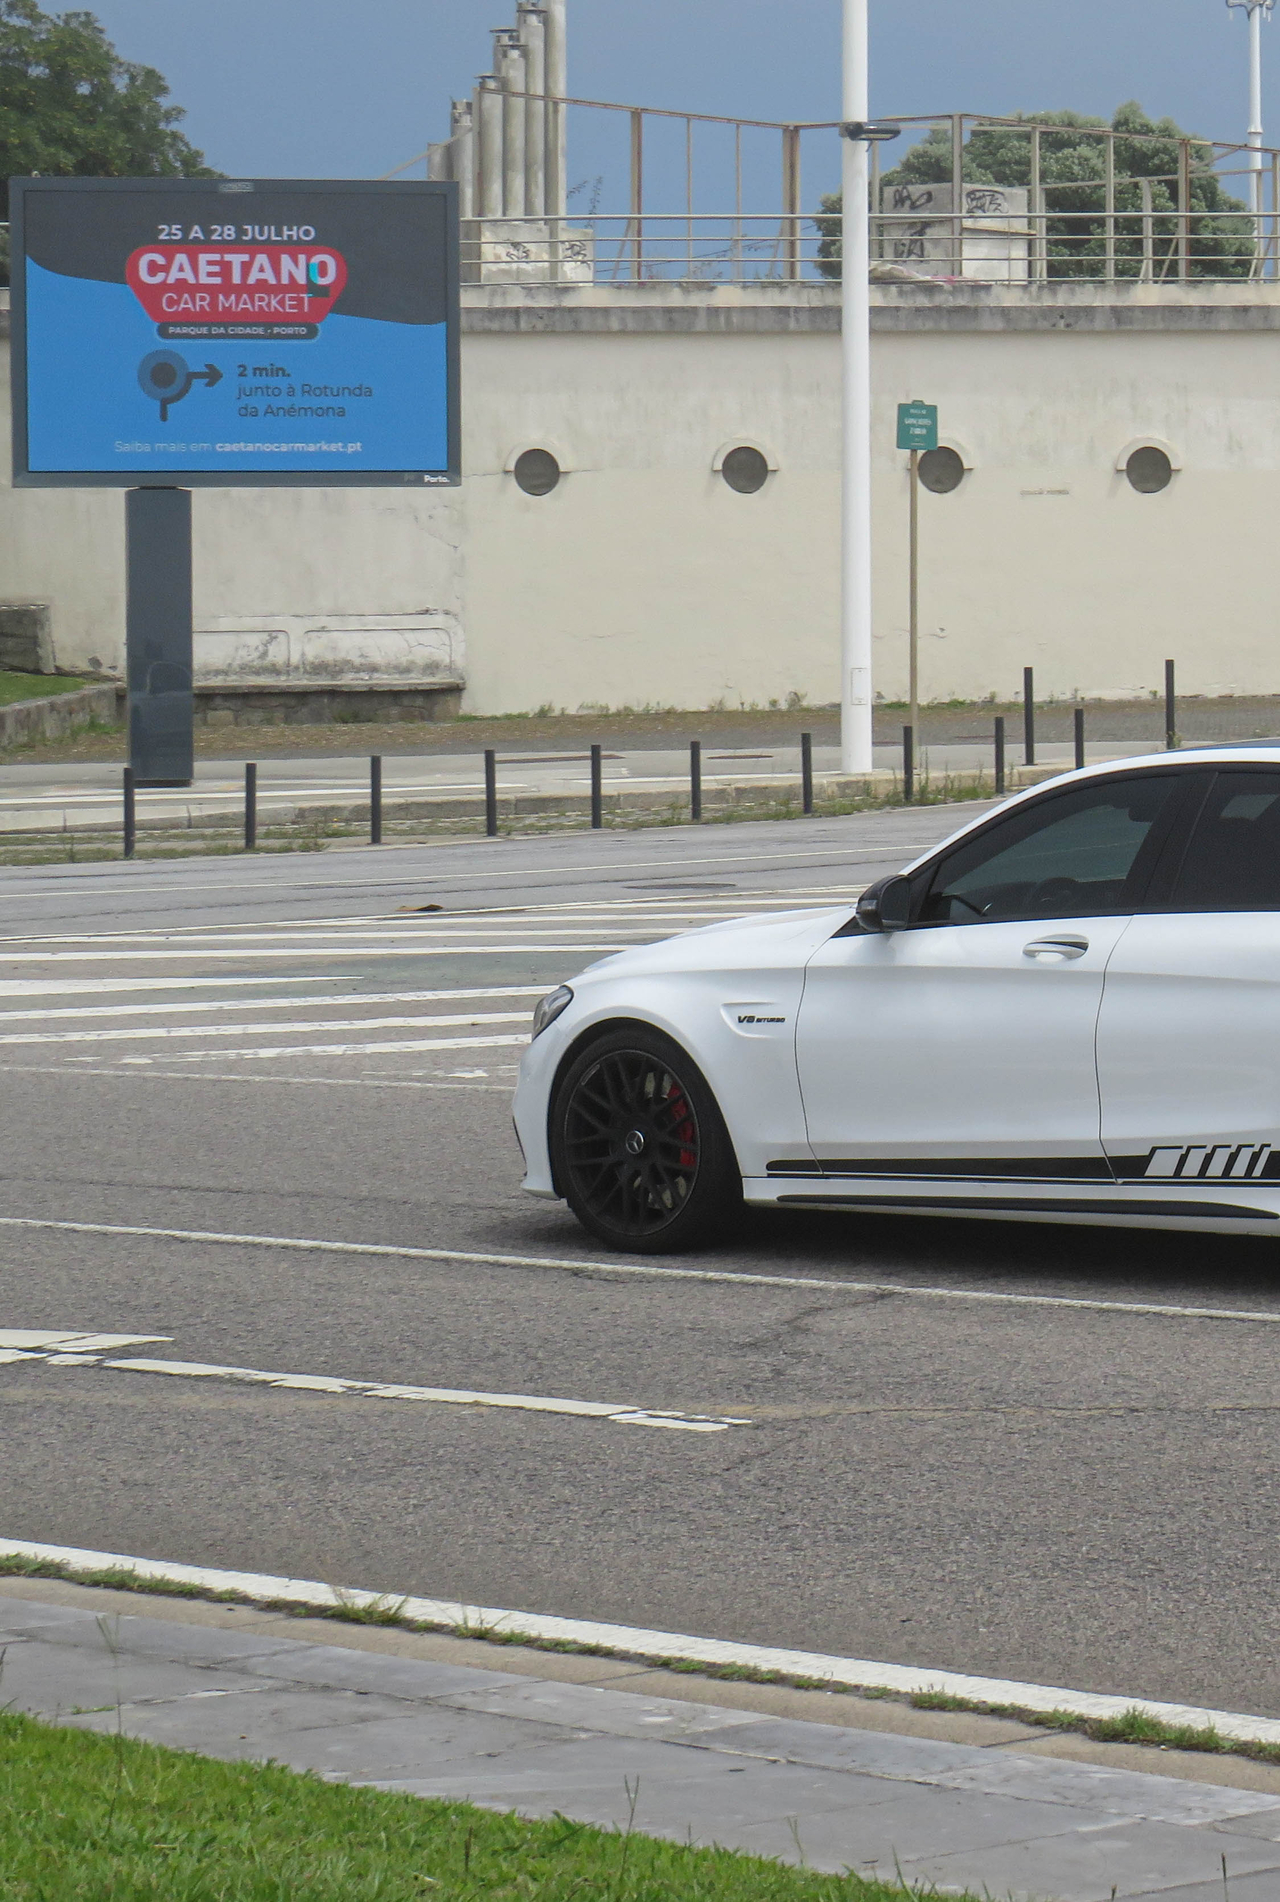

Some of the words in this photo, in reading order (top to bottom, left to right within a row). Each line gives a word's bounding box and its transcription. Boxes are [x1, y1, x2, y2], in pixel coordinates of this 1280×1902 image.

[157, 225, 182, 240] 25
[188, 225, 205, 240] A
[210, 225, 236, 240] 28
[241, 225, 316, 241] JULHO
[138, 253, 337, 285] CAETANO
[162, 293, 211, 312] CAR
[218, 293, 313, 313] MARKET
[168, 326, 209, 335] PARQUE
[211, 326, 226, 335] DA
[228, 326, 265, 335] CIDADE
[273, 326, 308, 335] PORTO
[237, 364, 248, 378] 2
[252, 363, 291, 378] min.
[236, 384, 282, 400] junto
[287, 383, 296, 398] à
[301, 383, 373, 398] Rotunda
[238, 404, 259, 418] da
[263, 403, 346, 418] Anémona
[114, 441, 150, 453] Saiba
[155, 441, 187, 453] mais
[190, 443, 211, 453] em
[215, 441, 363, 455] caetanocarmarket.pt
[737, 1015, 756, 1024] V8
